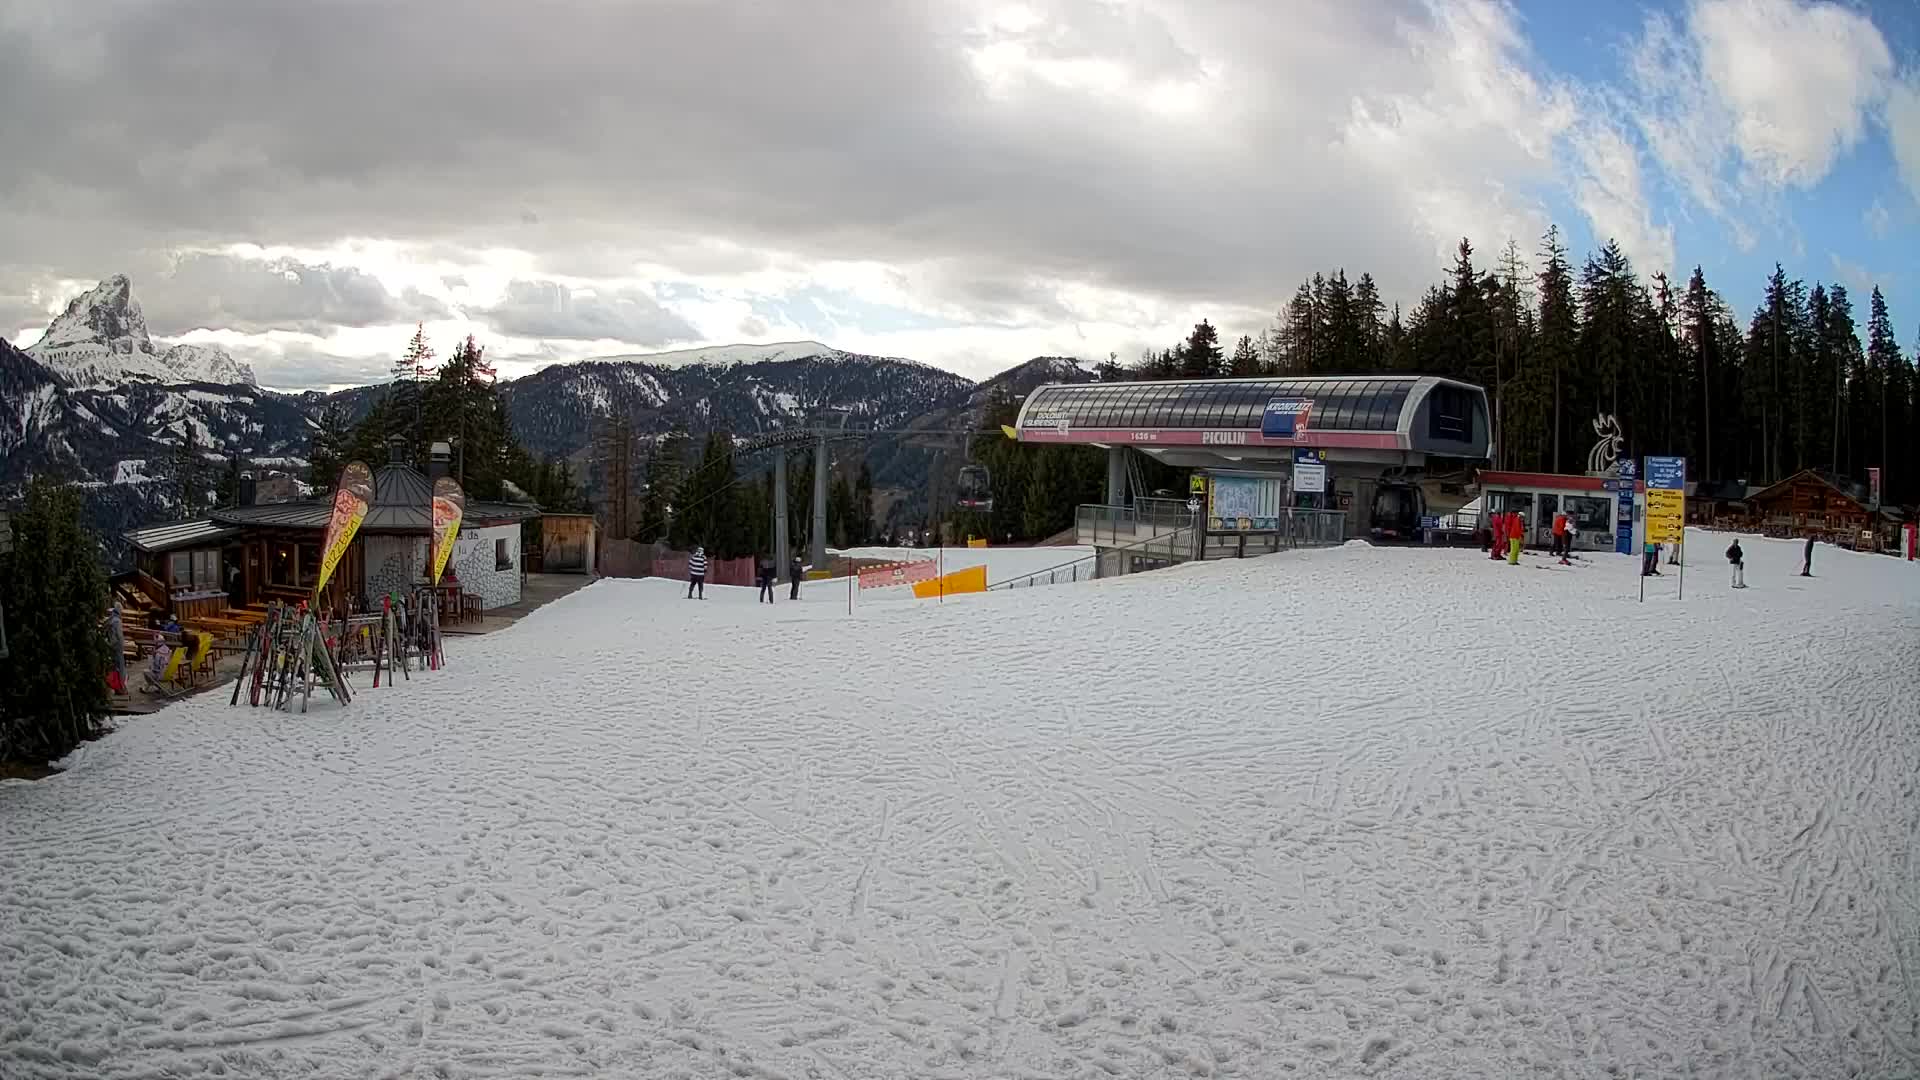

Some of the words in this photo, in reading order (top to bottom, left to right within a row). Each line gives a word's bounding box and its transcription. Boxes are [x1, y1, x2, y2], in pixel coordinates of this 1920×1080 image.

[1266, 402, 1313, 411] KRONPLATZ
[1202, 431, 1246, 444] PICULIN
[324, 520, 360, 570] PIZZERIA
